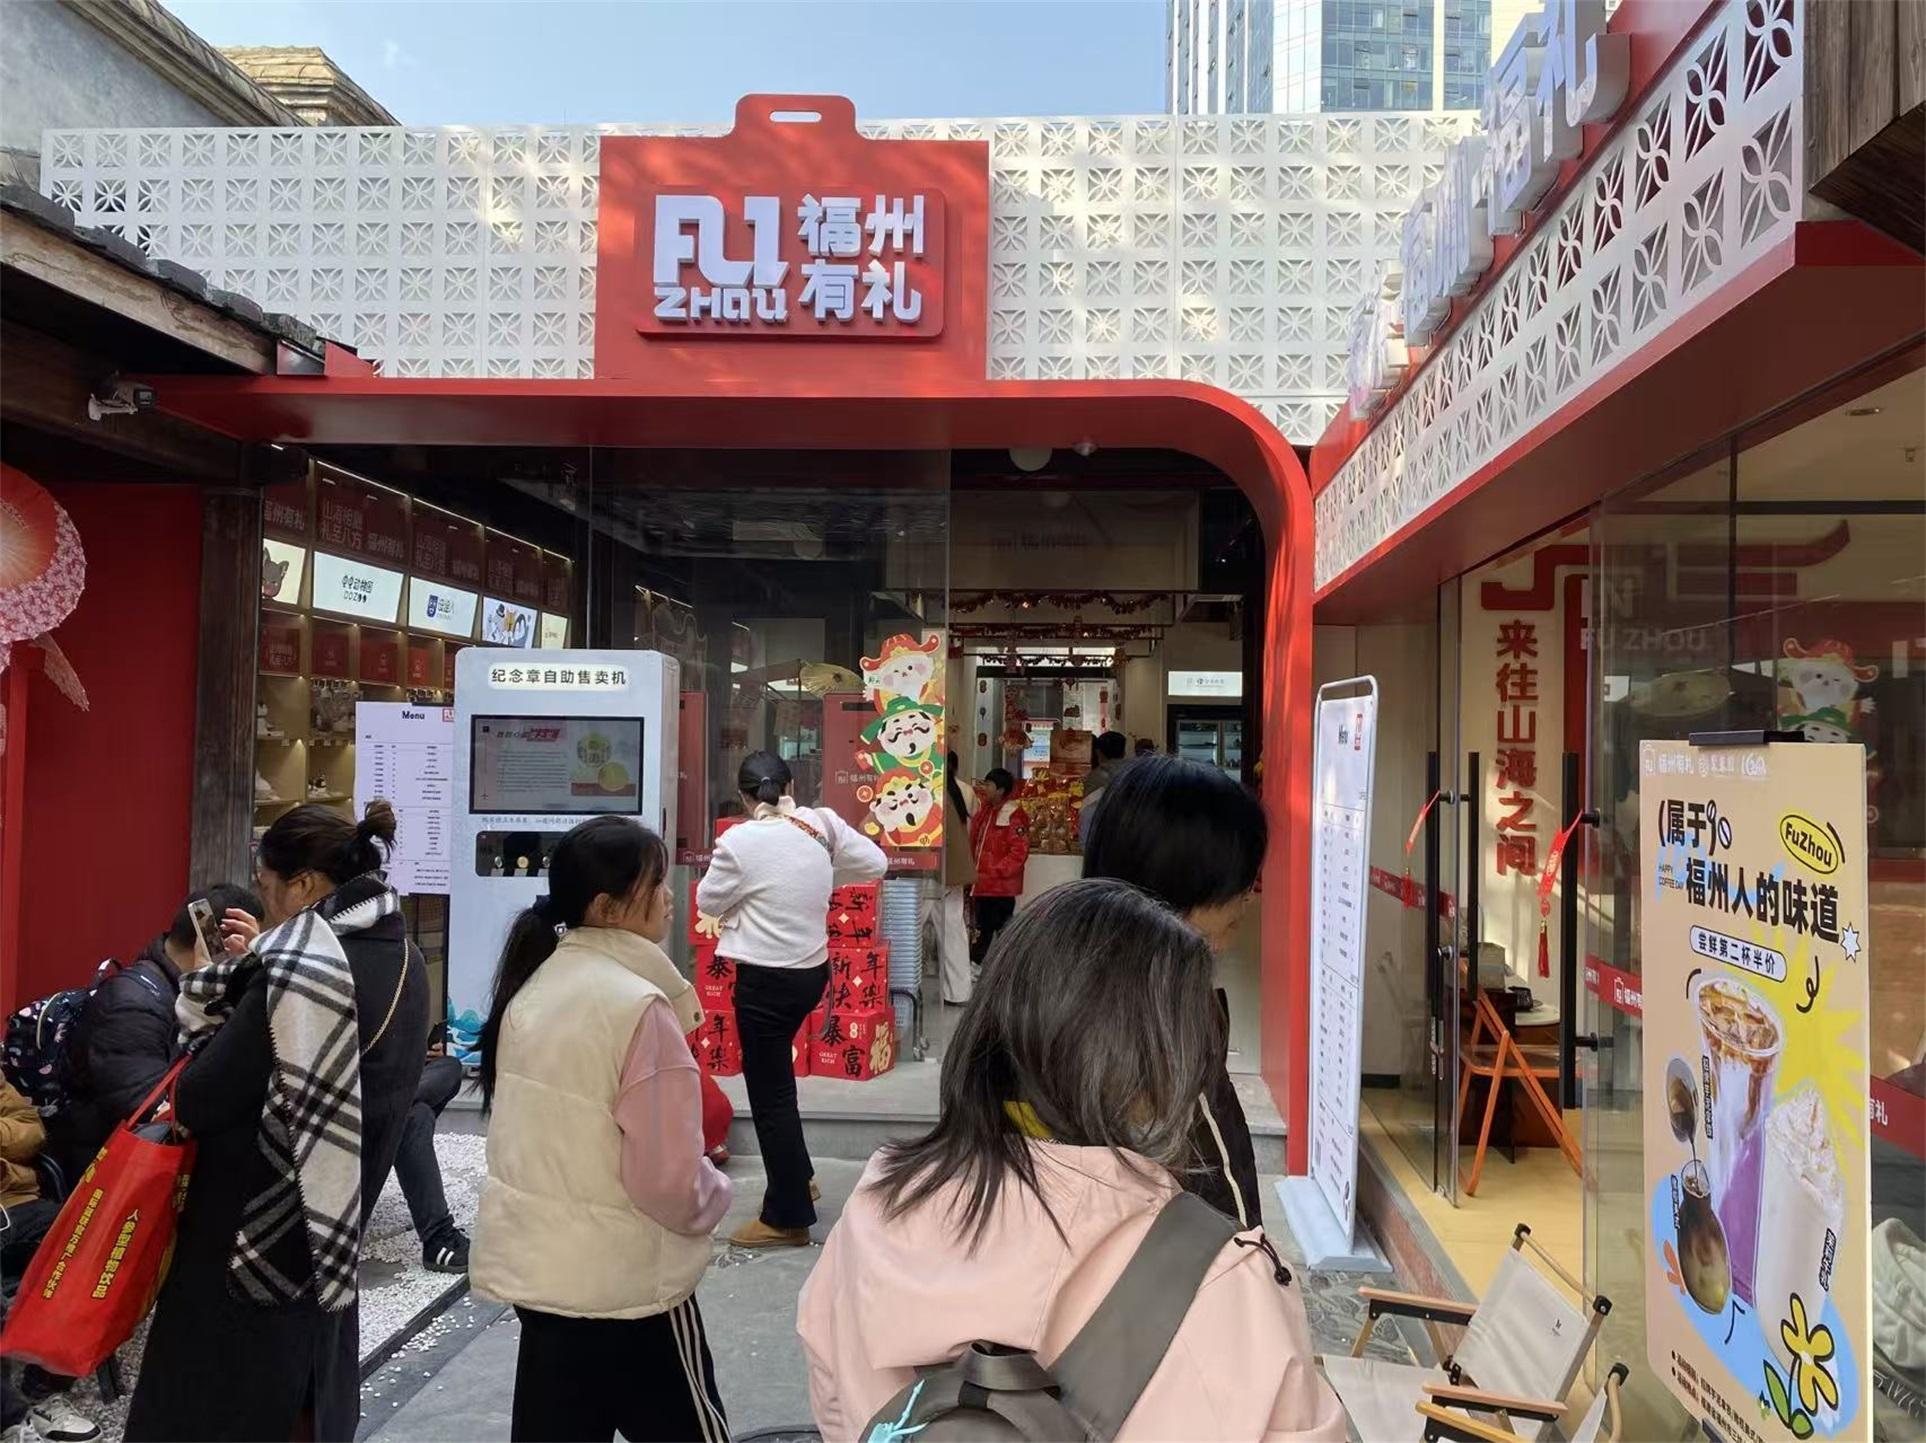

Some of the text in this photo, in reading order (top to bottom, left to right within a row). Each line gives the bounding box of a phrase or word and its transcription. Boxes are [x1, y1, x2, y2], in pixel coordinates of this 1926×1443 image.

[798, 193, 925, 257] 福州
[799, 259, 922, 325] 有礼
[491, 668, 626, 685] 纪念章自助售卖机
[402, 710, 425, 720] Menu
[1496, 619, 1539, 877] 来往山海之间
[1785, 822, 1832, 867] FuZhou
[1686, 857, 1840, 943] 福州人的味道
[1699, 932, 1775, 975] 尝鲜第二杯半价
[819, 1051, 837, 1059] GREAT
